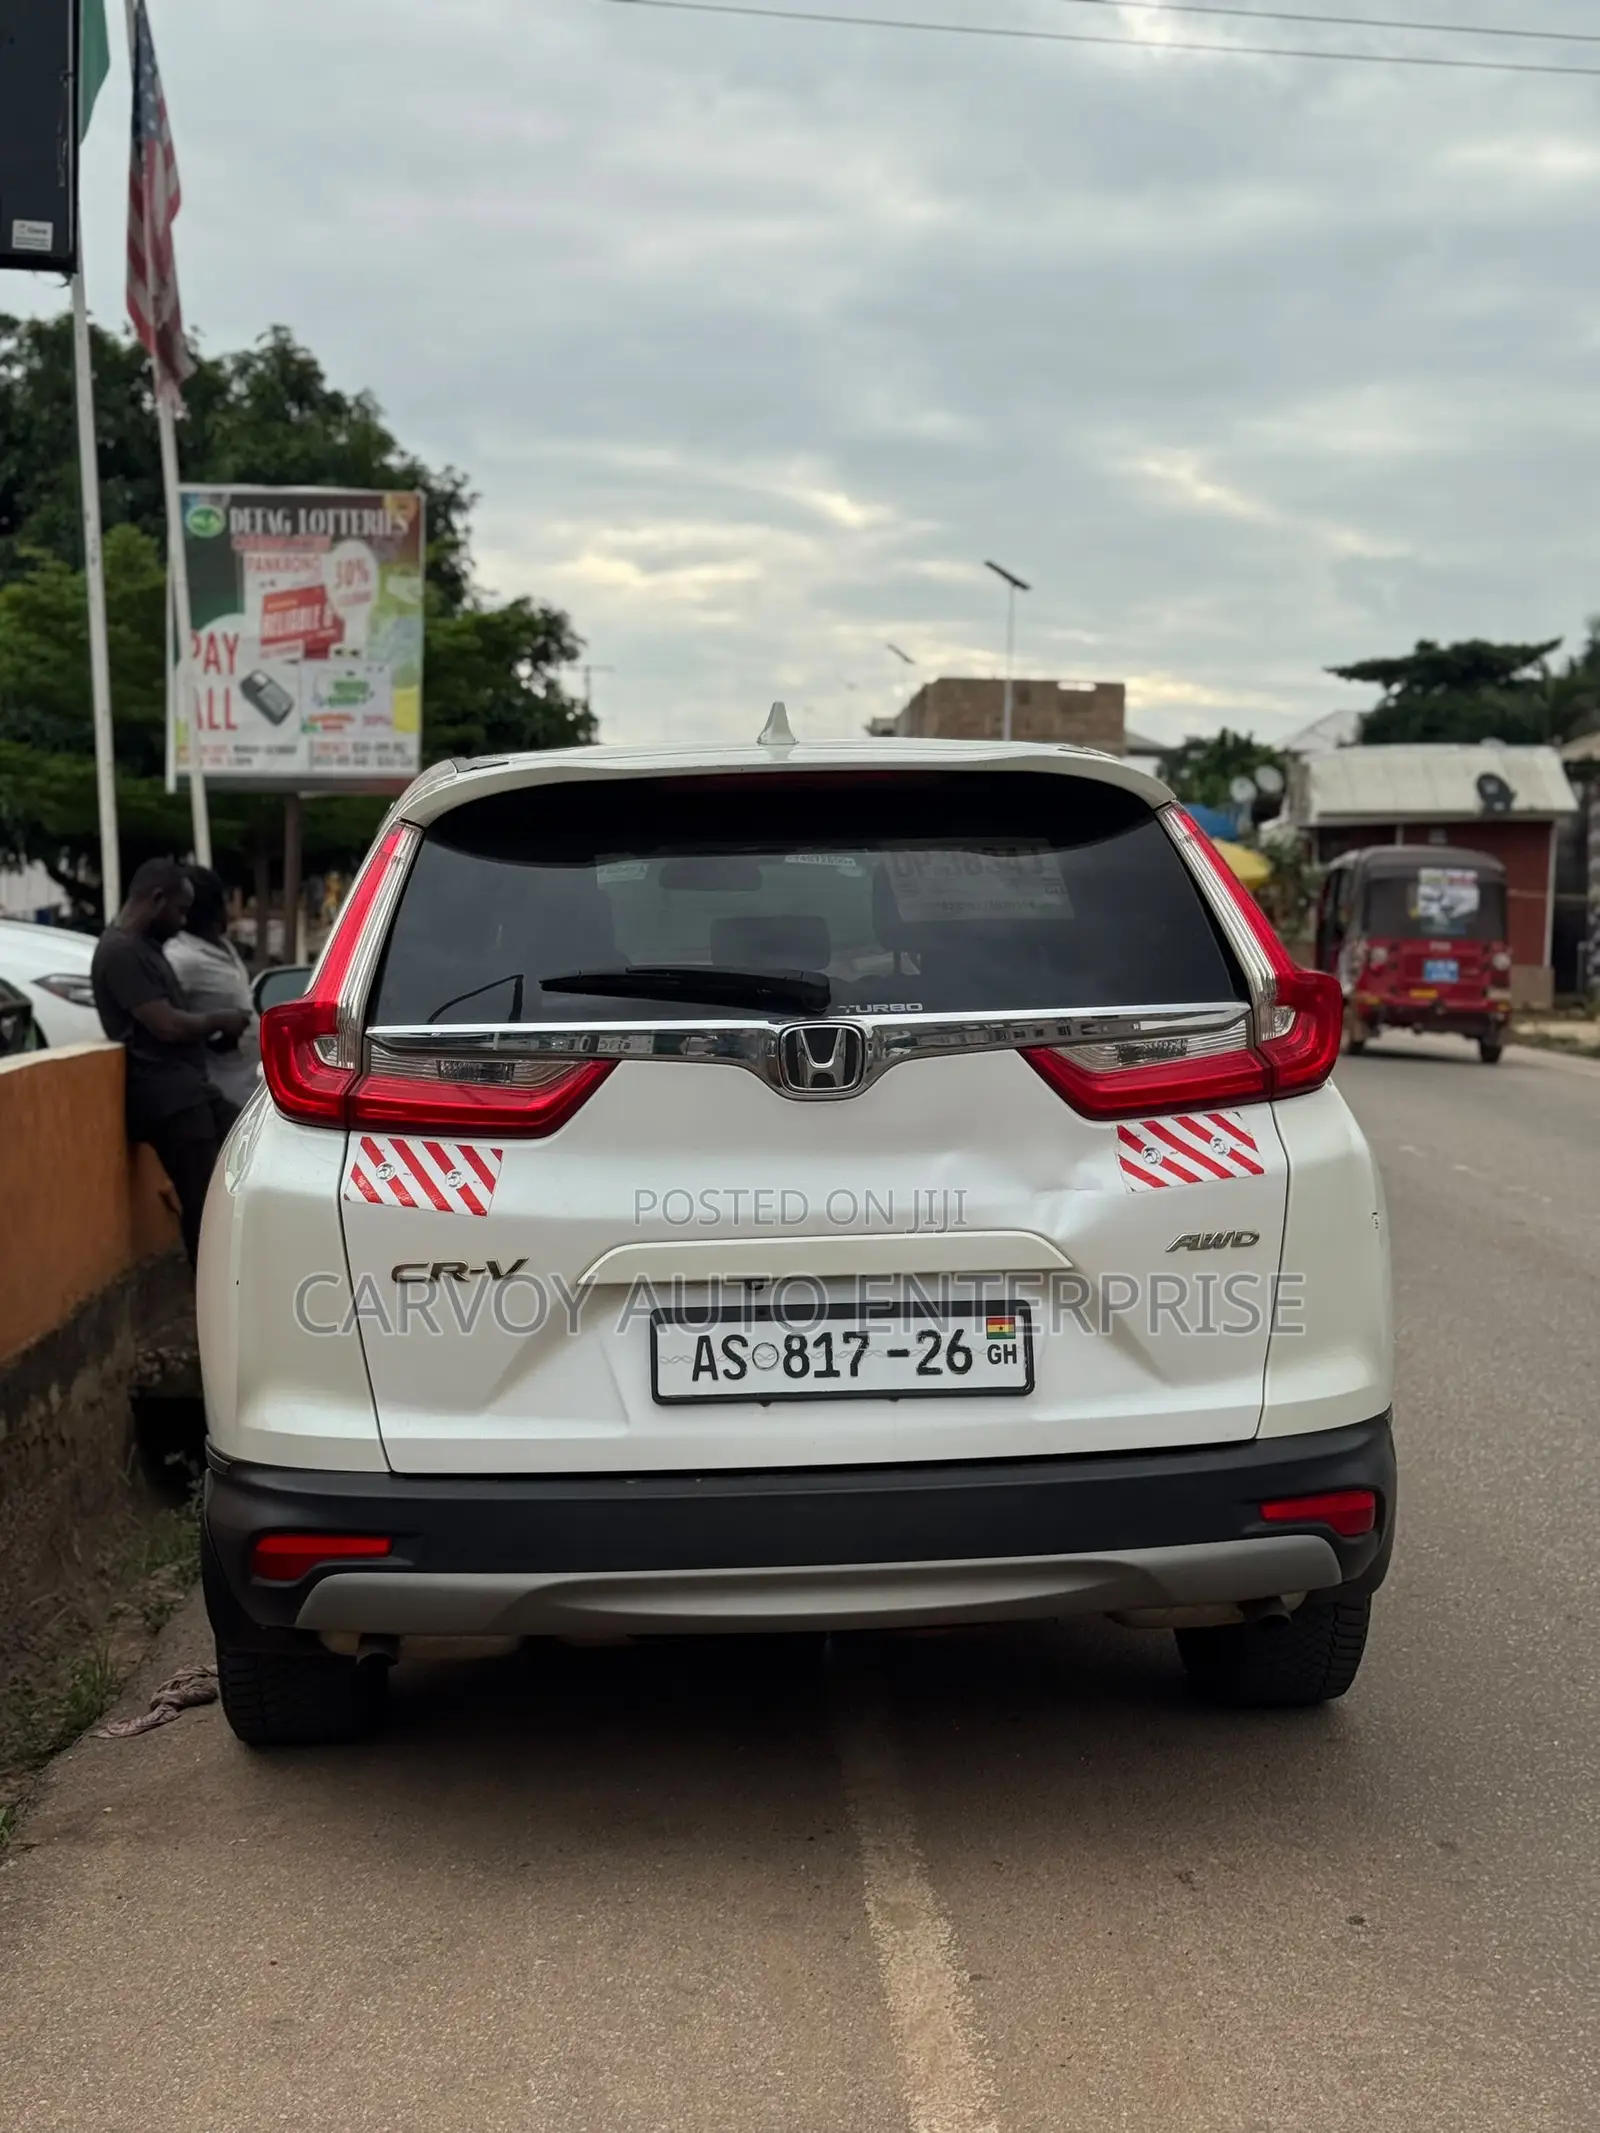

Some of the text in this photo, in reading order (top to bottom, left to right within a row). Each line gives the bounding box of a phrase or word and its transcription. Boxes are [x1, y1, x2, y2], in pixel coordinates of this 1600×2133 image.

[298, 508, 407, 536] LOTTERIES
[838, 1003, 923, 1013] TURBO
[1164, 1229, 1261, 1252] AWD
[391, 1256, 531, 1283] CR-V
[691, 1335, 748, 1381] AS
[783, 1332, 869, 1379] 817
[986, 1343, 1018, 1366] GH
